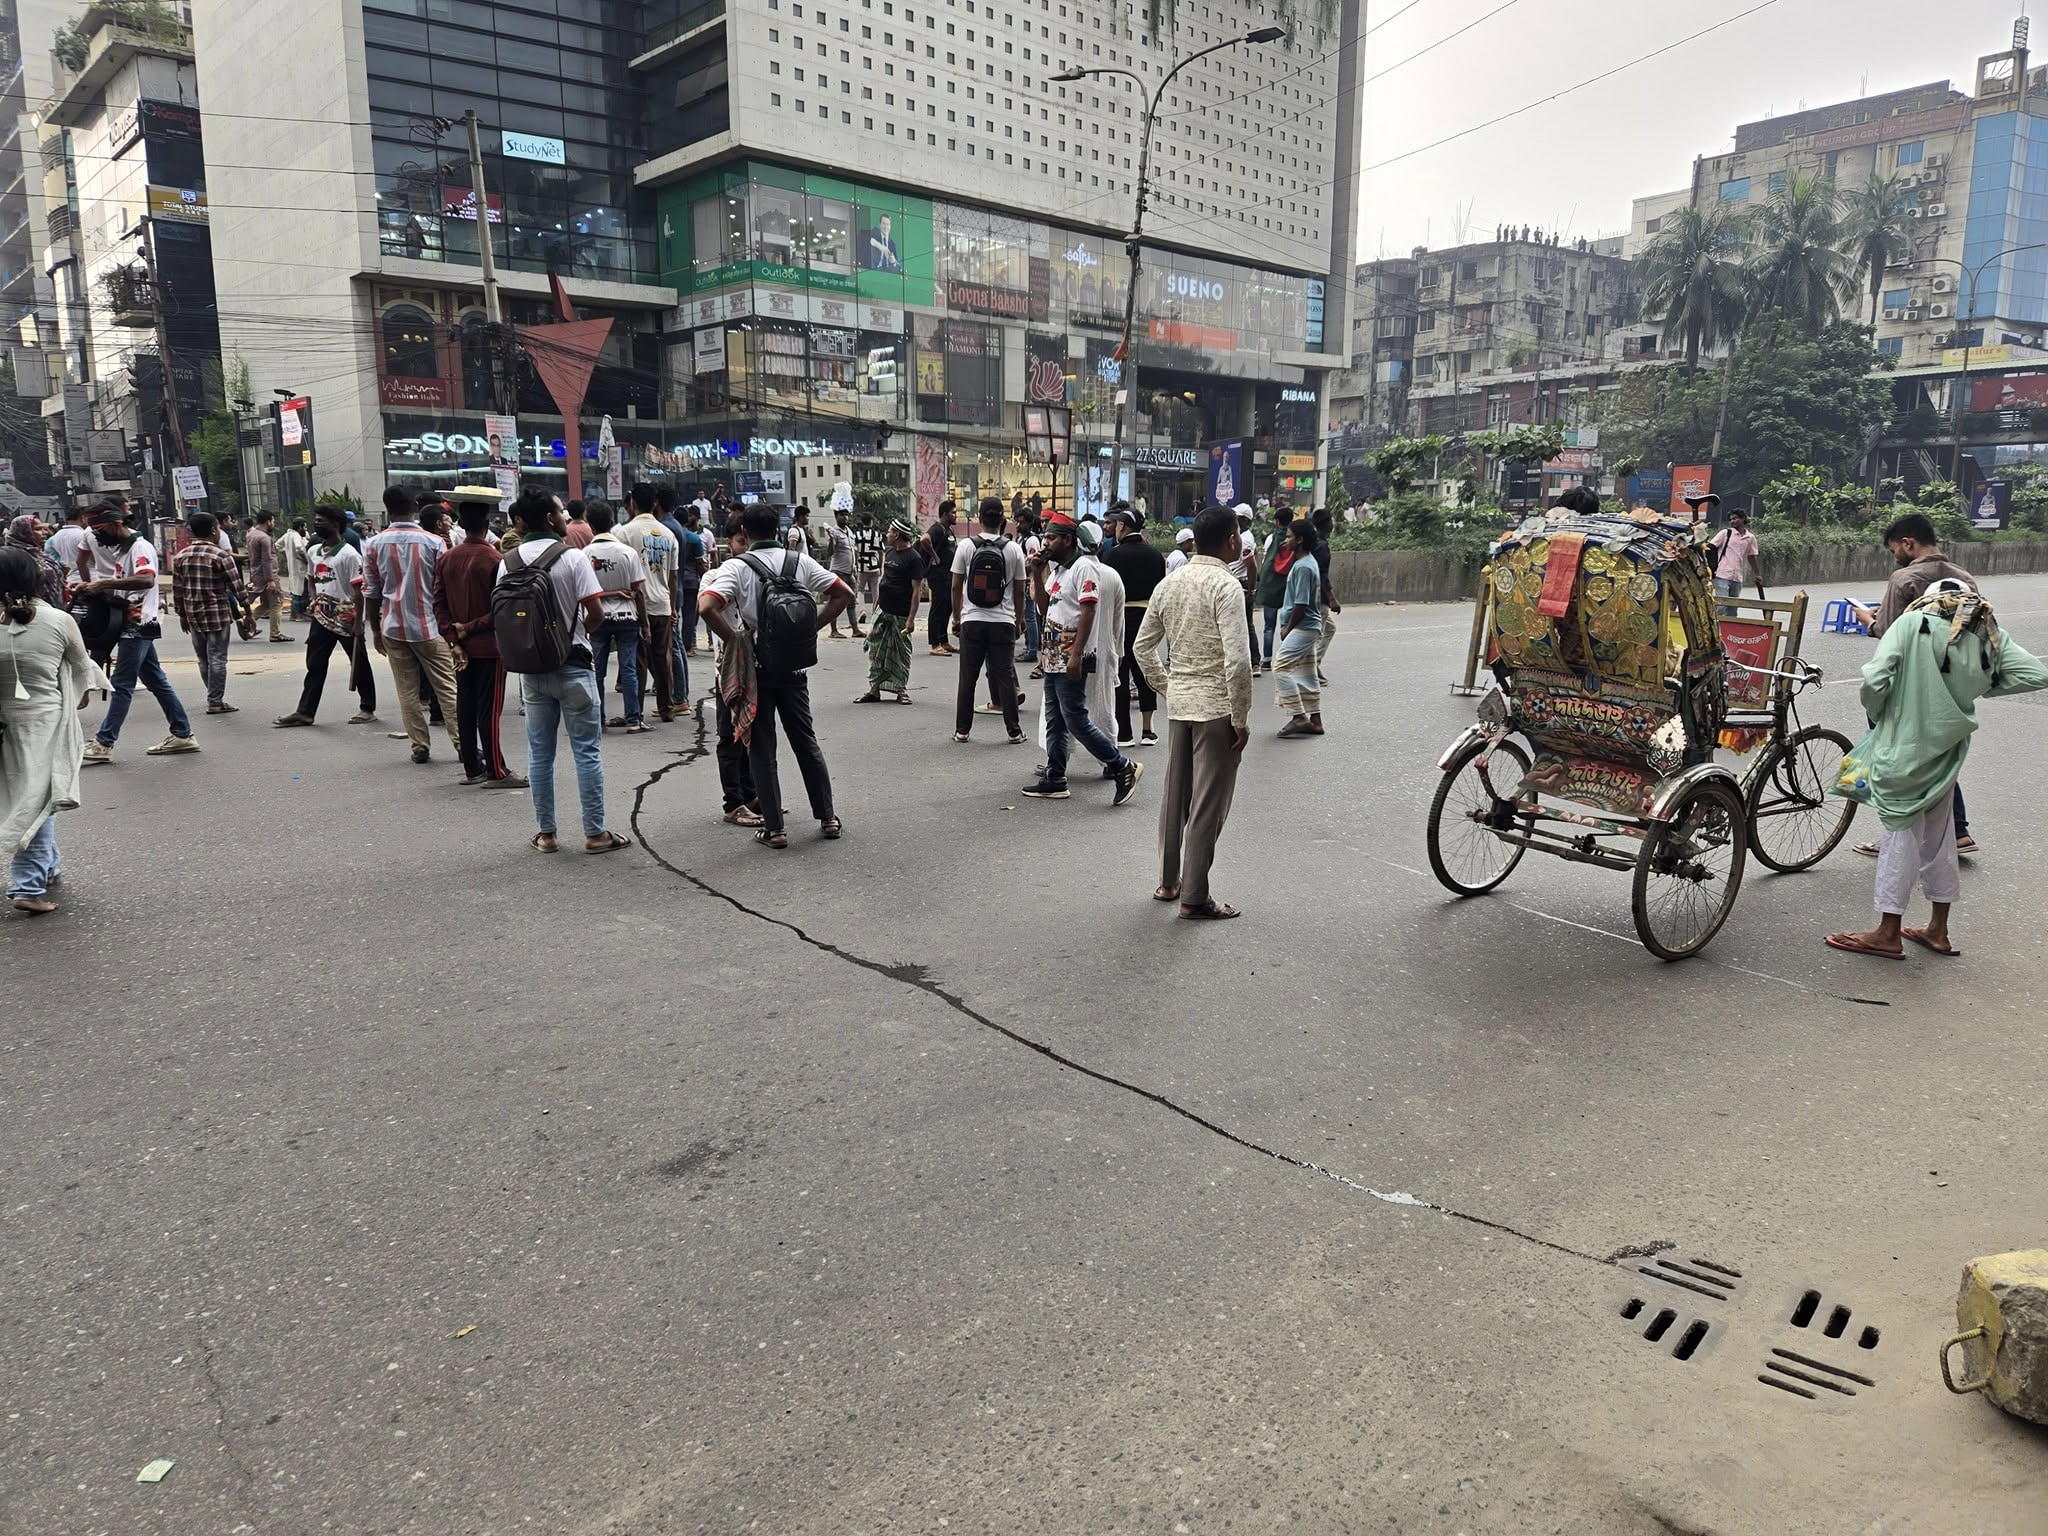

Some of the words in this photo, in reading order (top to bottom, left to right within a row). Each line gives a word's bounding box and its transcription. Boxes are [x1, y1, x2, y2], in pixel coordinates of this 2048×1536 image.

[506, 139, 560, 159] StudyNet
[761, 267, 801, 282] Outlook
[1167, 272, 1224, 301] SUENO
[949, 281, 988, 312] Goyna
[990, 288, 1029, 314] Baksho
[421, 432, 522, 455] SON
[674, 442, 713, 459] SONY
[750, 438, 815, 456] SONY
[1136, 447, 1149, 462] 27
[1150, 449, 1197, 465] SQUARE
